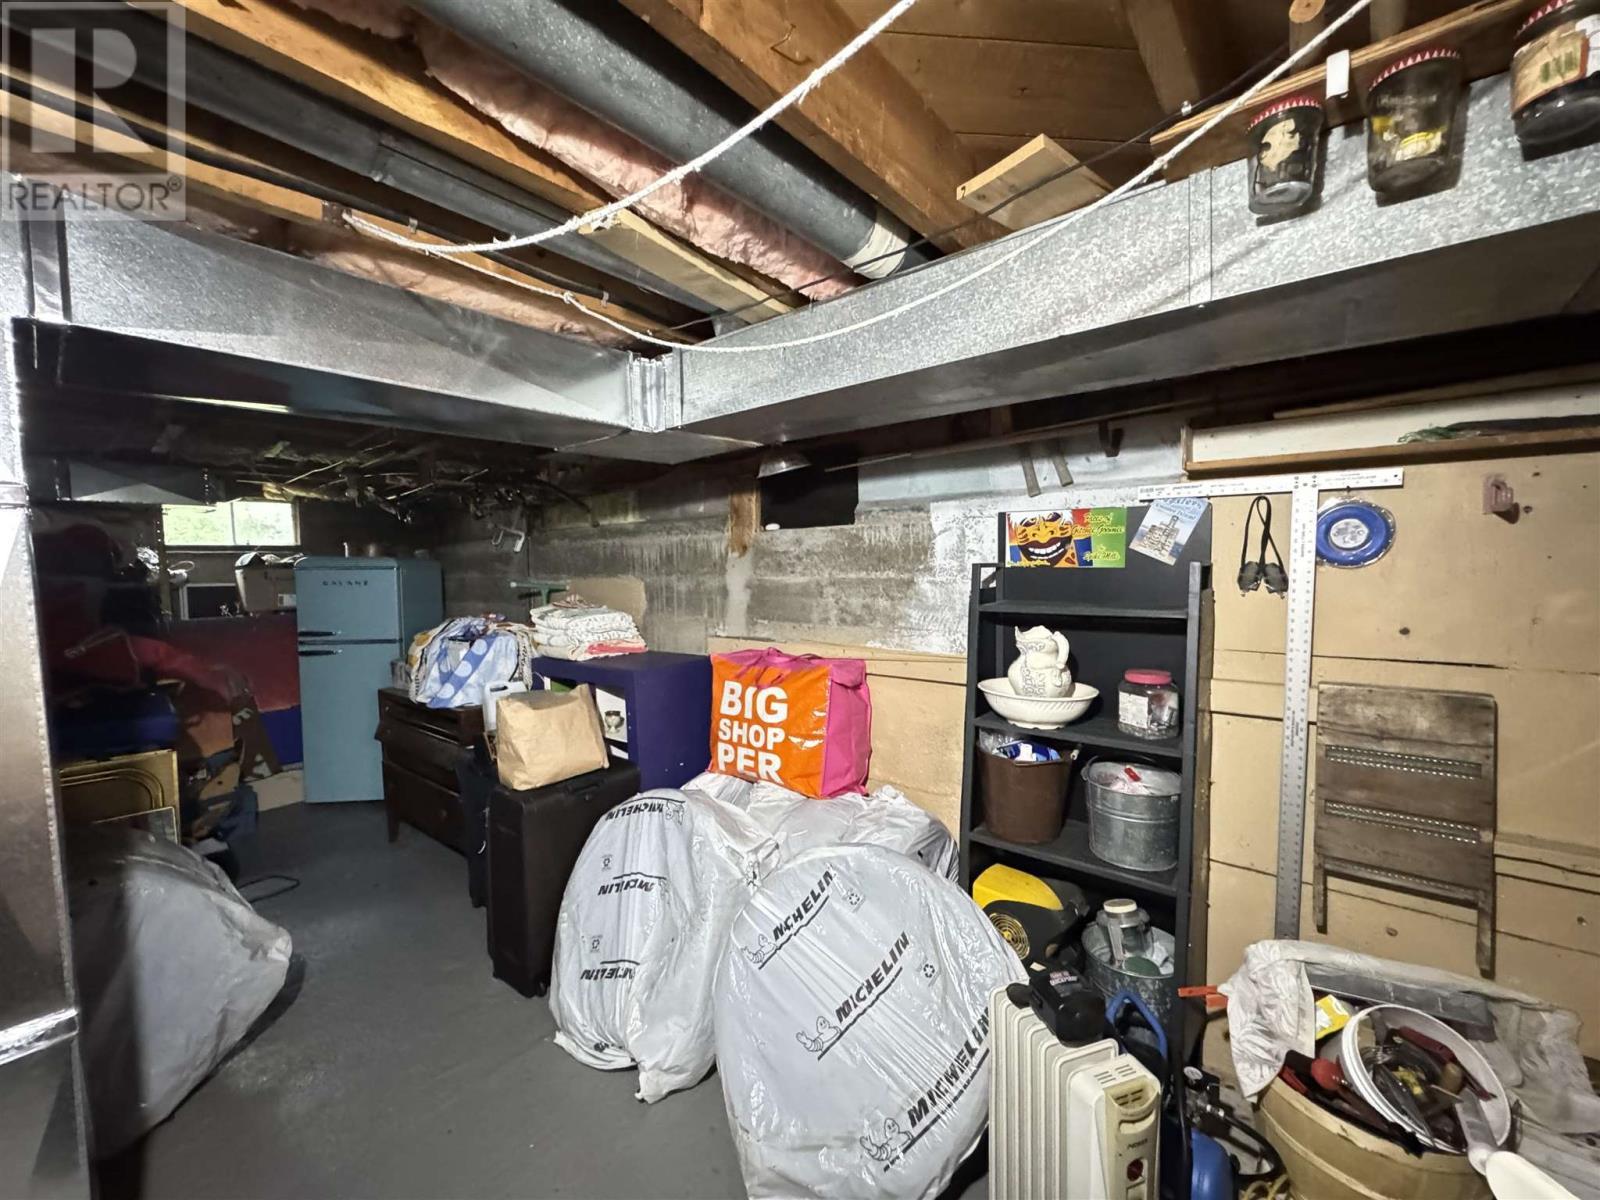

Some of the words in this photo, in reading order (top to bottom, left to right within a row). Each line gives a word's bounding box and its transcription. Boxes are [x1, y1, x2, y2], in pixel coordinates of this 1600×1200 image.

[720, 680, 788, 724] BIG
[718, 718, 786, 750] SHOP
[717, 742, 785, 785] PER
[605, 802, 664, 822] MICHELIN
[772, 868, 837, 942] MCHELIN
